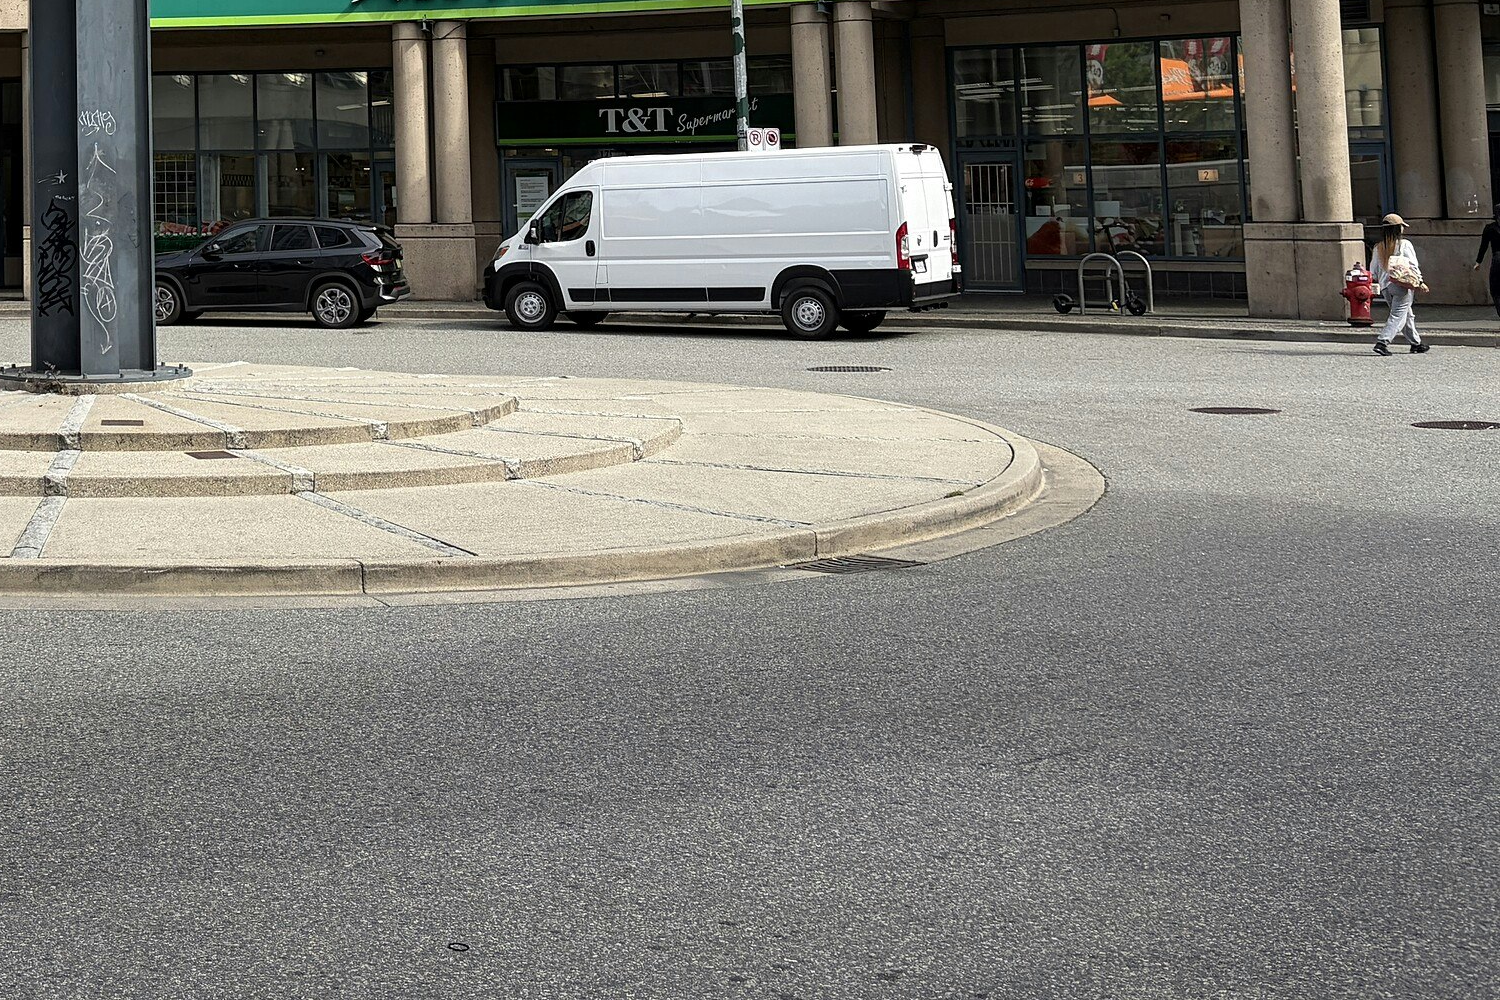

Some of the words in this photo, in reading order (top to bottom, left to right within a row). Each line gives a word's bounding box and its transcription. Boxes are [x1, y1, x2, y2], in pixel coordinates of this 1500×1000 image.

[599, 108, 674, 133] T&T
[676, 97, 758, 136] Supermart
[1077, 174, 1083, 183] 3
[1203, 171, 1209, 180] 2
